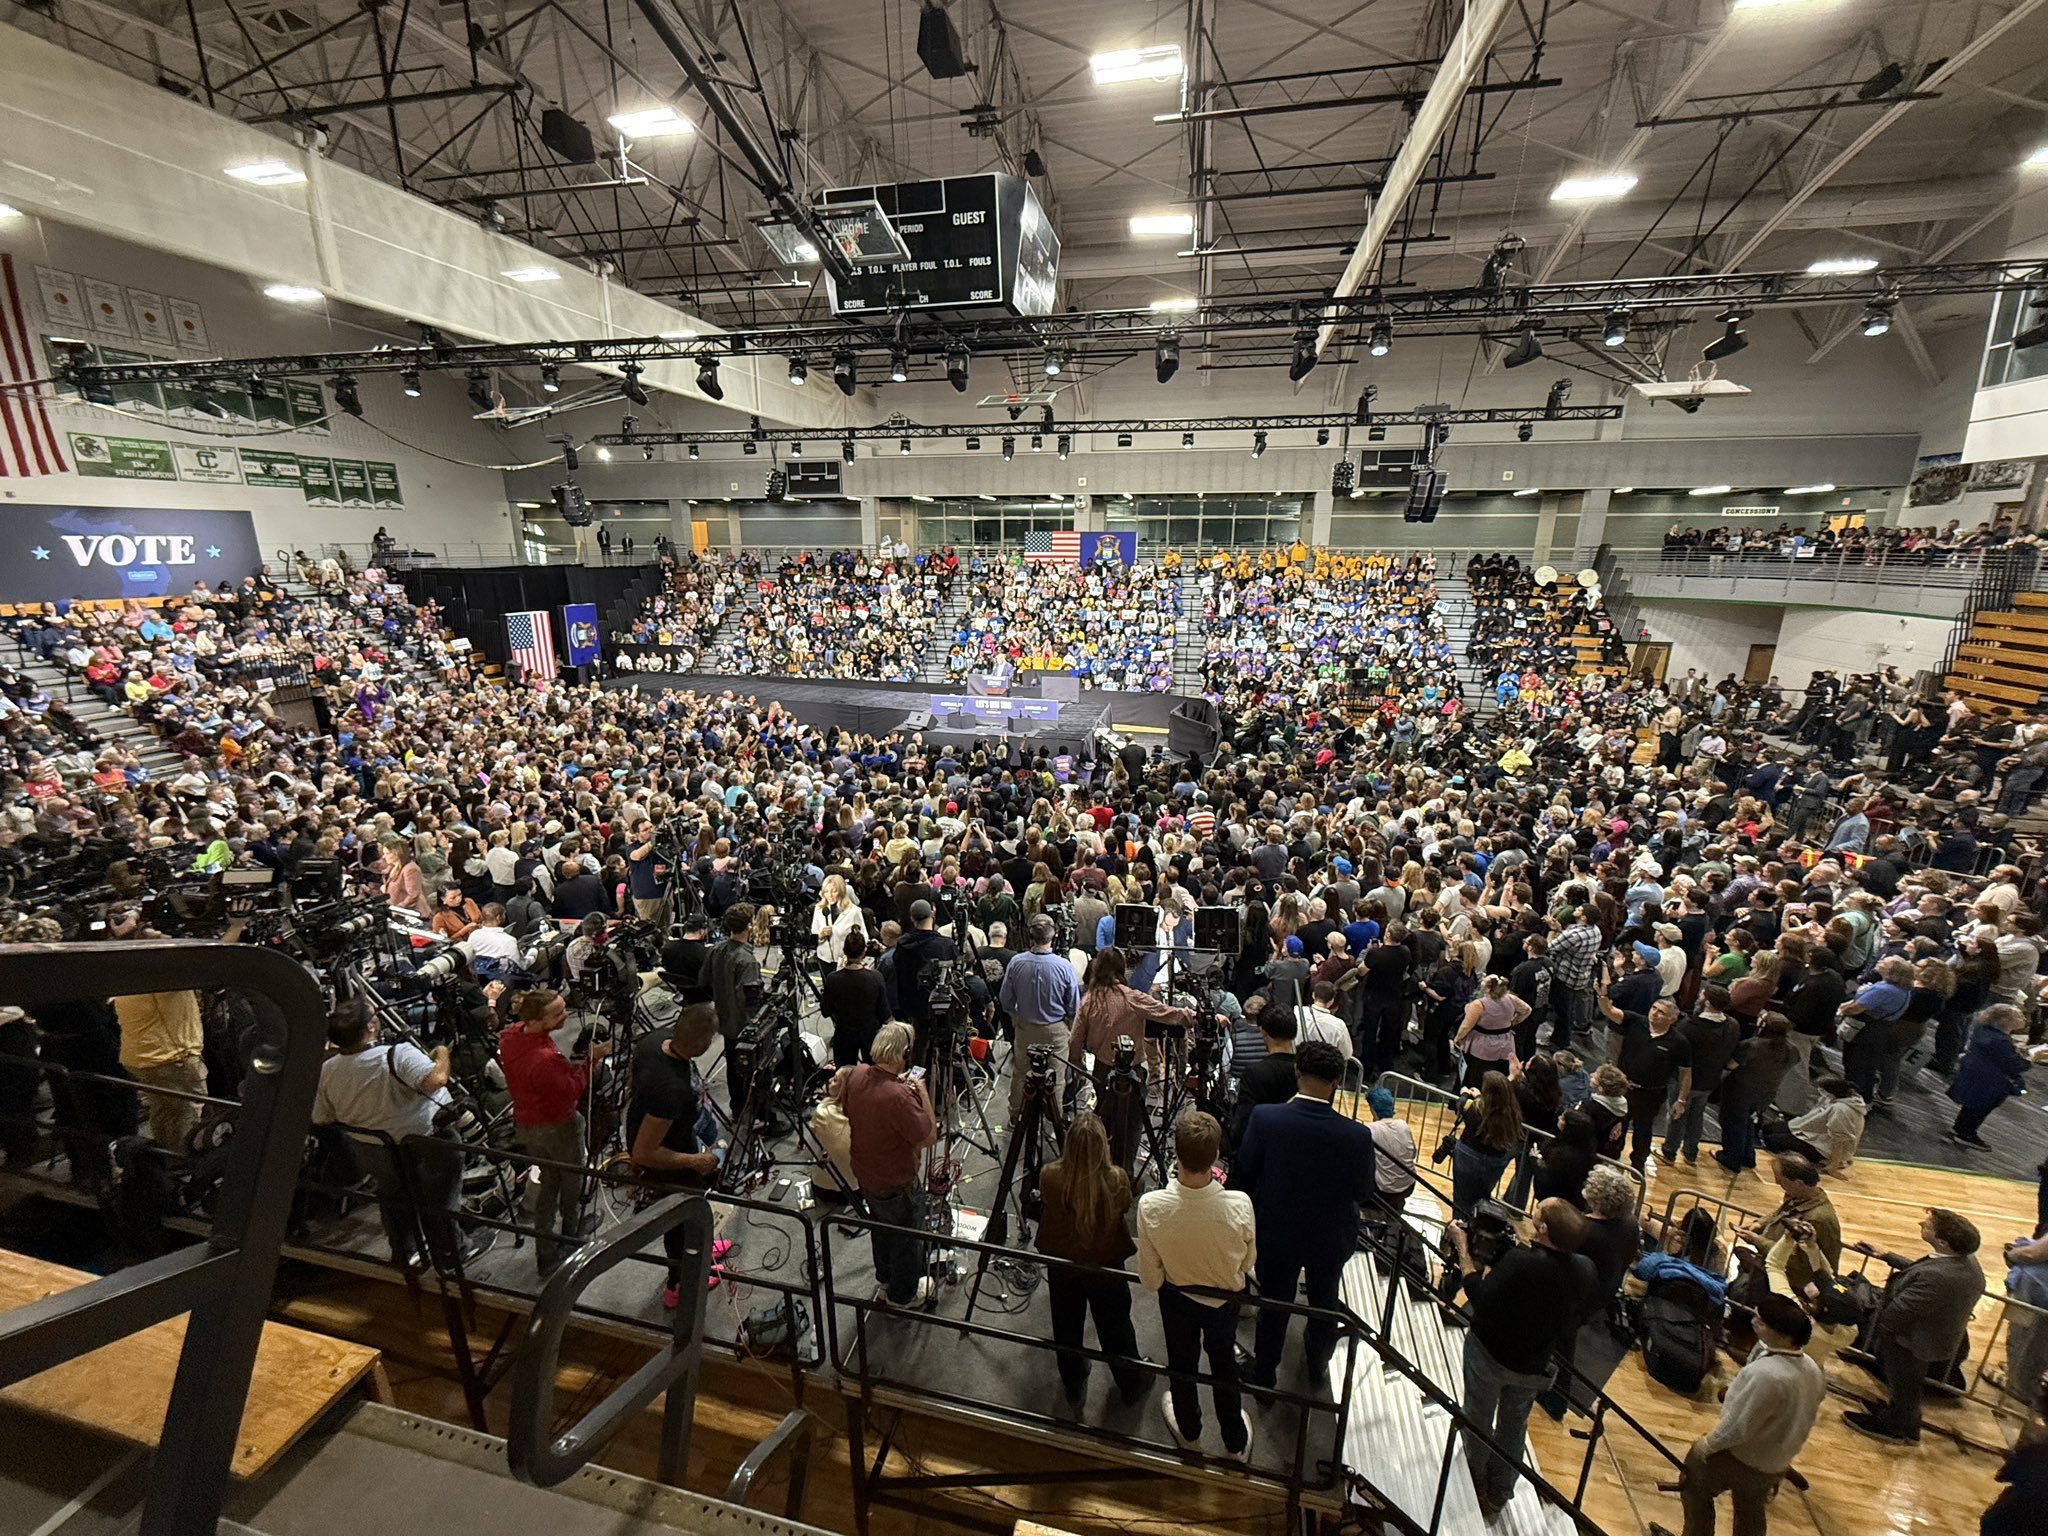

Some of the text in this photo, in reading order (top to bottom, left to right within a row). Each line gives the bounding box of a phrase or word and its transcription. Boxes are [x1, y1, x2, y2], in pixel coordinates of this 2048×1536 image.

[952, 211, 985, 226] GUEST
[841, 222, 870, 235] HOME
[900, 224, 924, 234] PERIOD
[944, 259, 963, 269] T.O.L.
[969, 256, 992, 266] FOULS
[868, 265, 886, 275] T.O.L.
[892, 261, 938, 273] PLAYER FOUL
[970, 290, 993, 300] SCORE
[843, 299, 866, 309] SCORE
[61, 534, 196, 567] VOTE
